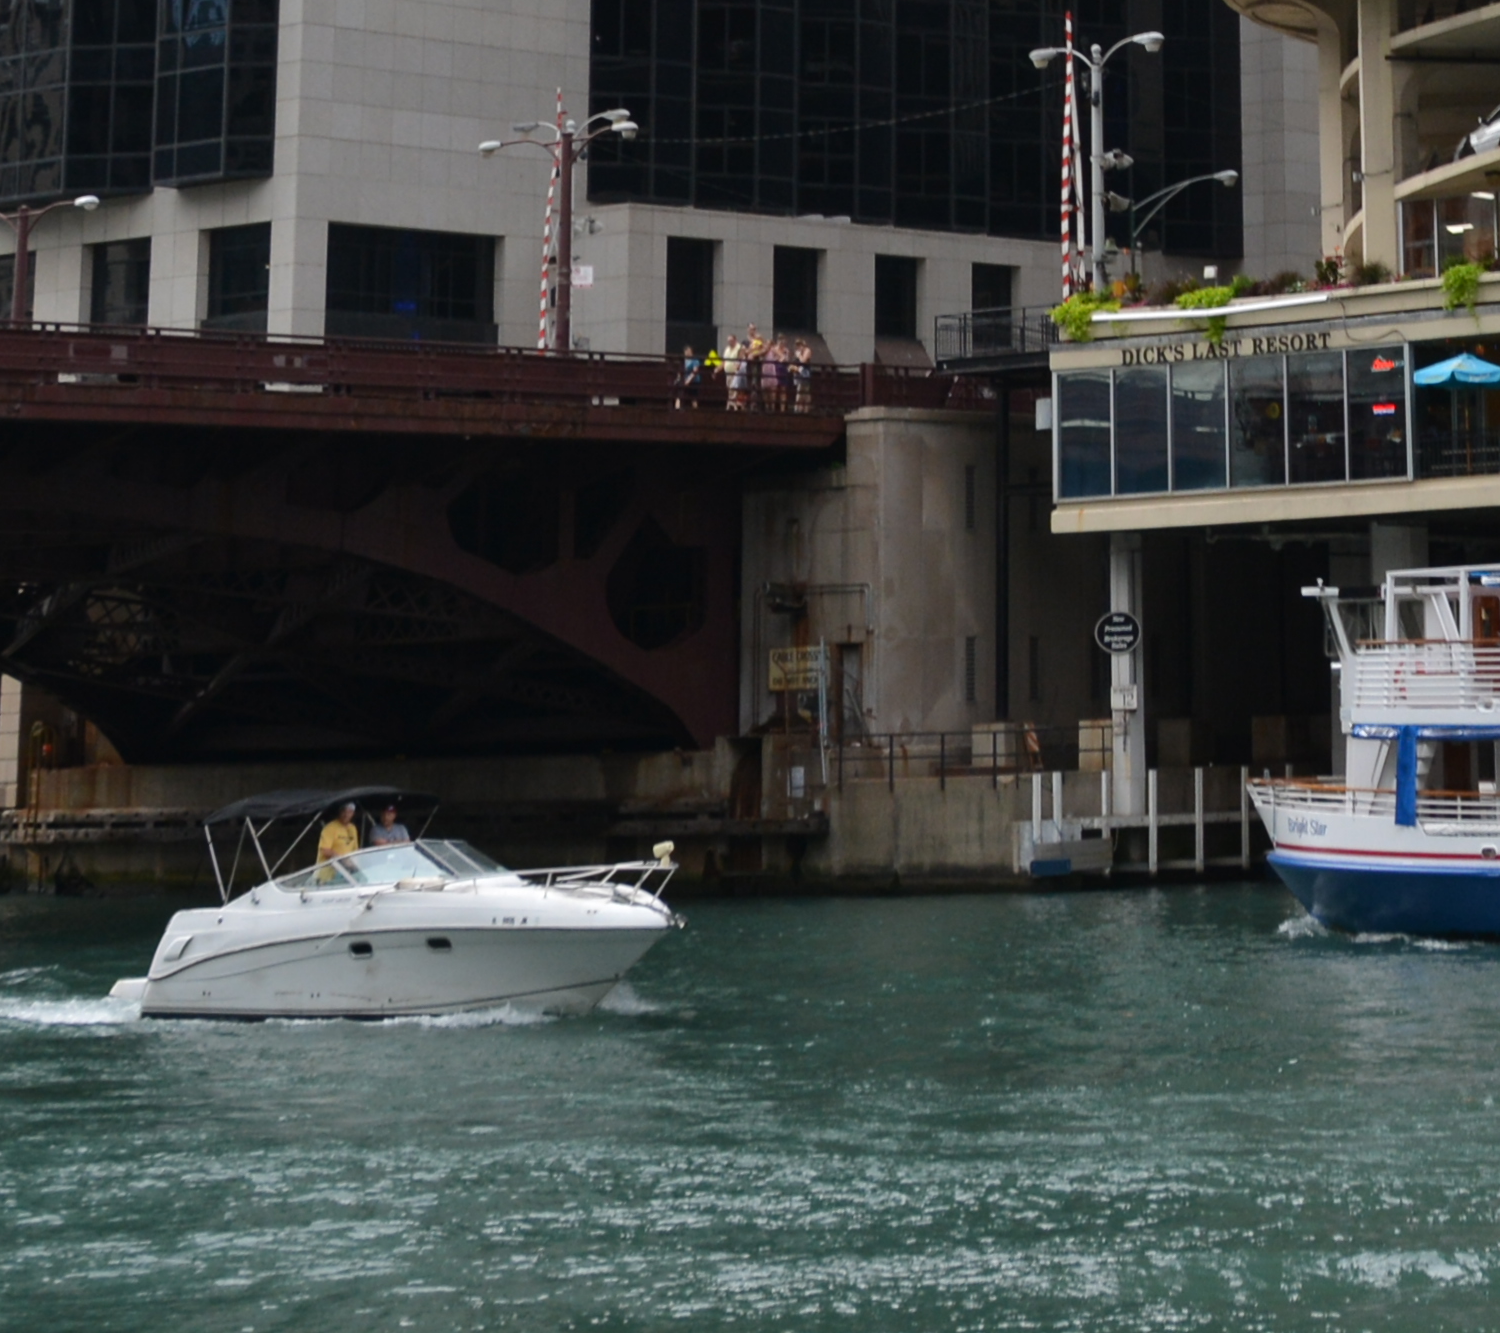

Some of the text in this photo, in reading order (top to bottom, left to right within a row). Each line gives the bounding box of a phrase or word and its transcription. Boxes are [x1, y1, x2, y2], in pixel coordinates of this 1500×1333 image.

[1121, 332, 1332, 366] DICK'S LAST RESORT
